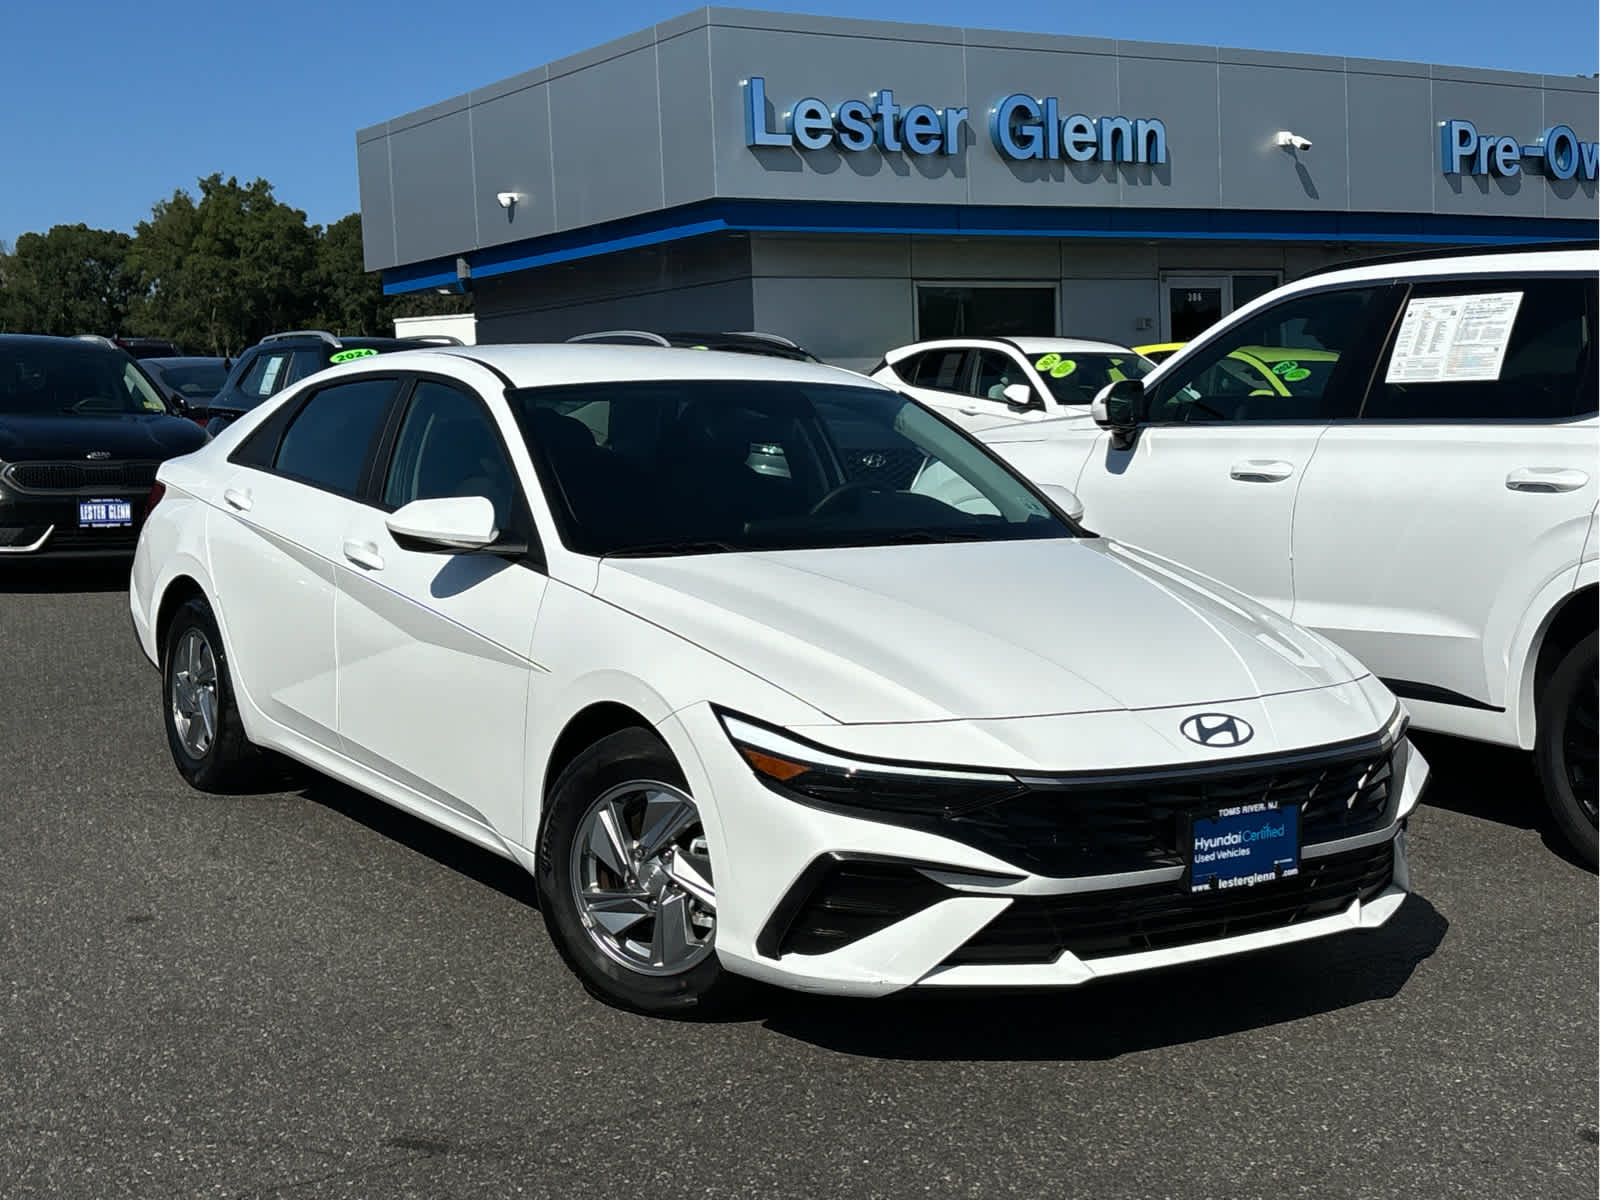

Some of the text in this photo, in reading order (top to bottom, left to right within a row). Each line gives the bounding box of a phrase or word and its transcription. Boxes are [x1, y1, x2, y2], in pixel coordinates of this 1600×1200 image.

[745, 77, 1167, 164] Lester Glenn
[336, 350, 374, 362] 2024
[79, 502, 131, 520] LESTER GLENN
[1219, 806, 1241, 817] TOMS
[1268, 801, 1279, 810] NJ
[1194, 831, 1242, 851] Hyundai
[1194, 847, 1251, 864] Used Vehicles
[1218, 872, 1276, 889] lesterglenn
